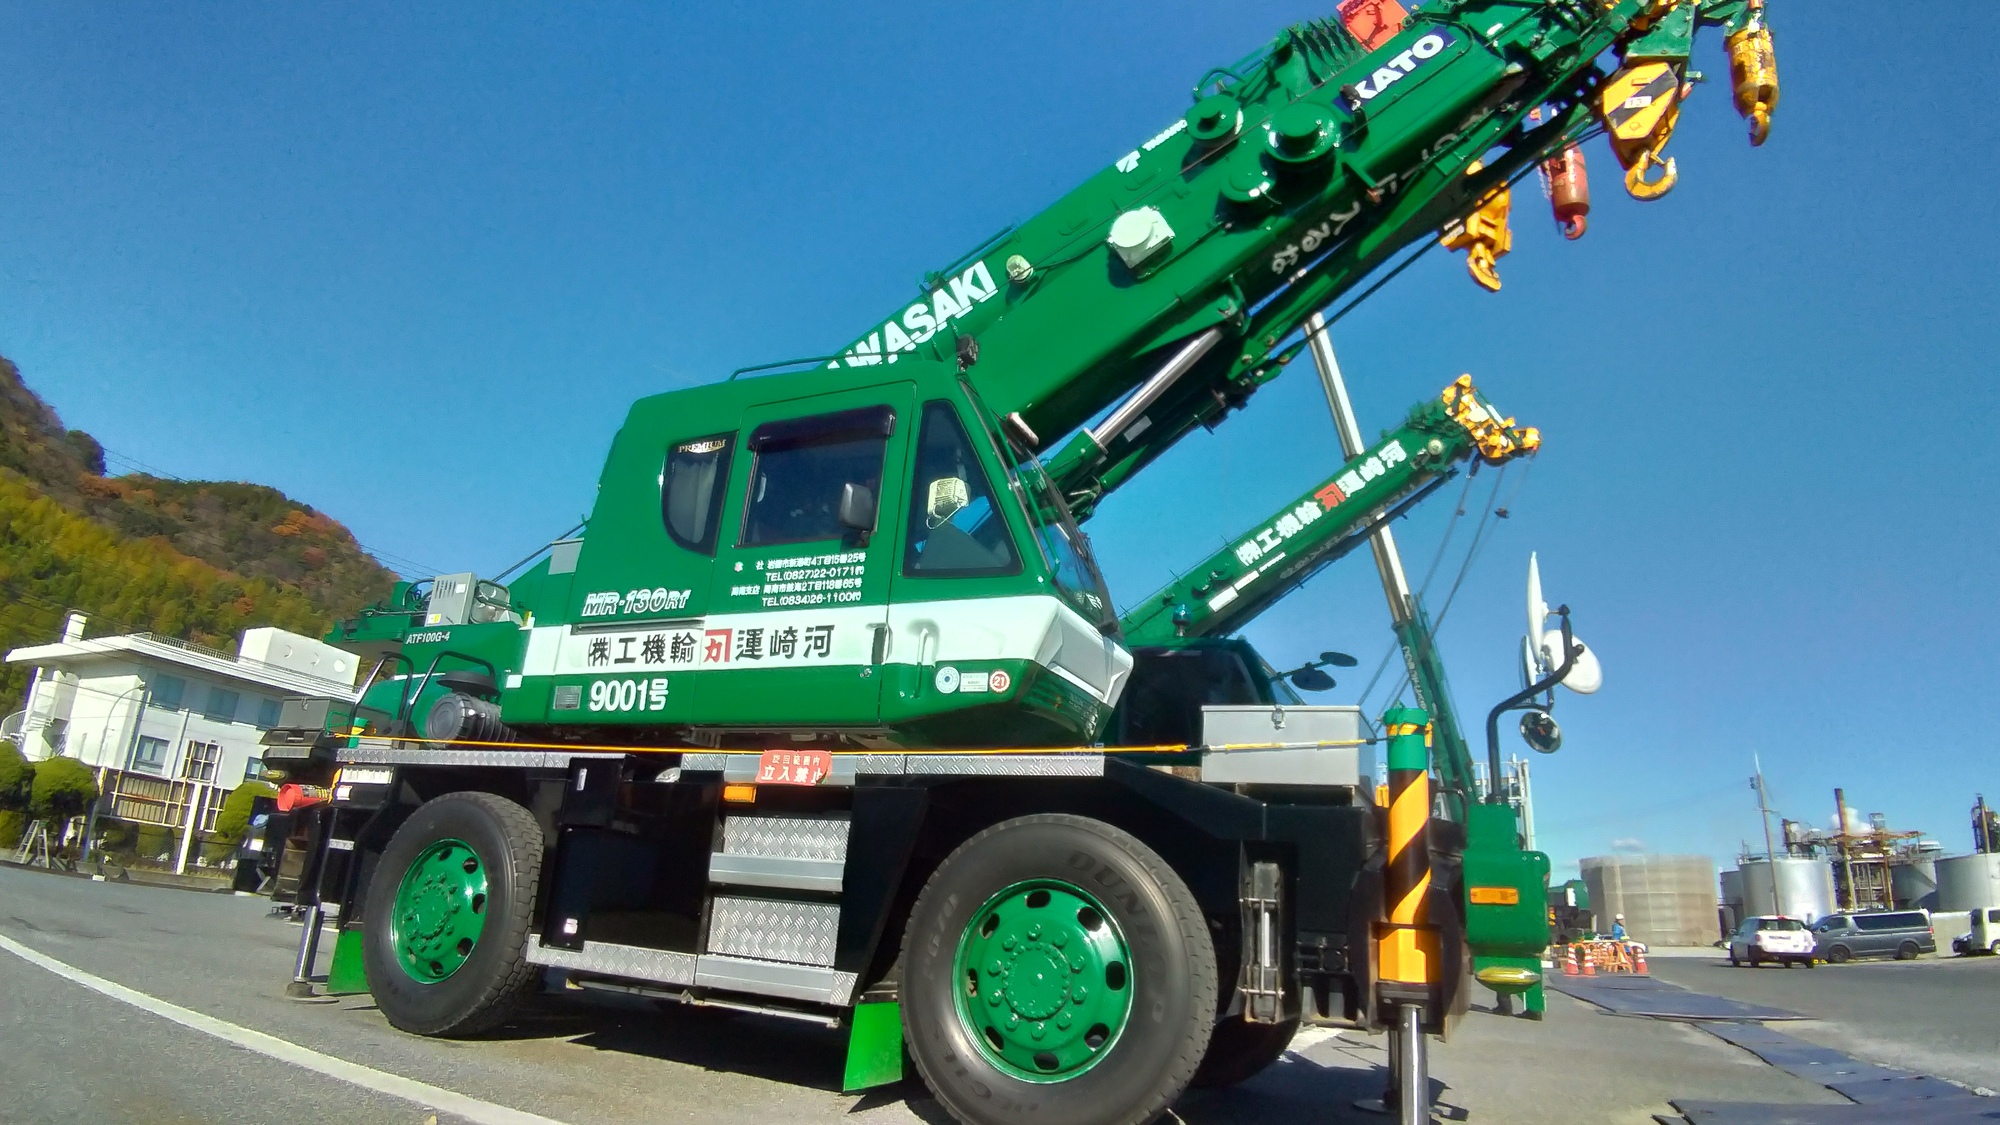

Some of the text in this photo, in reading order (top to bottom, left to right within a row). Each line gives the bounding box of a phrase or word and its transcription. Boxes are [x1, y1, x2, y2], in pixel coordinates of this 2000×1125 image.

[1353, 34, 1445, 99] KATO
[827, 259, 999, 370] WASAKI
[678, 439, 727, 454] PREMIUM
[405, 631, 451, 645] ATF100G-4
[993, 676, 1006, 688] 21
[589, 678, 669, 711] 9001号
